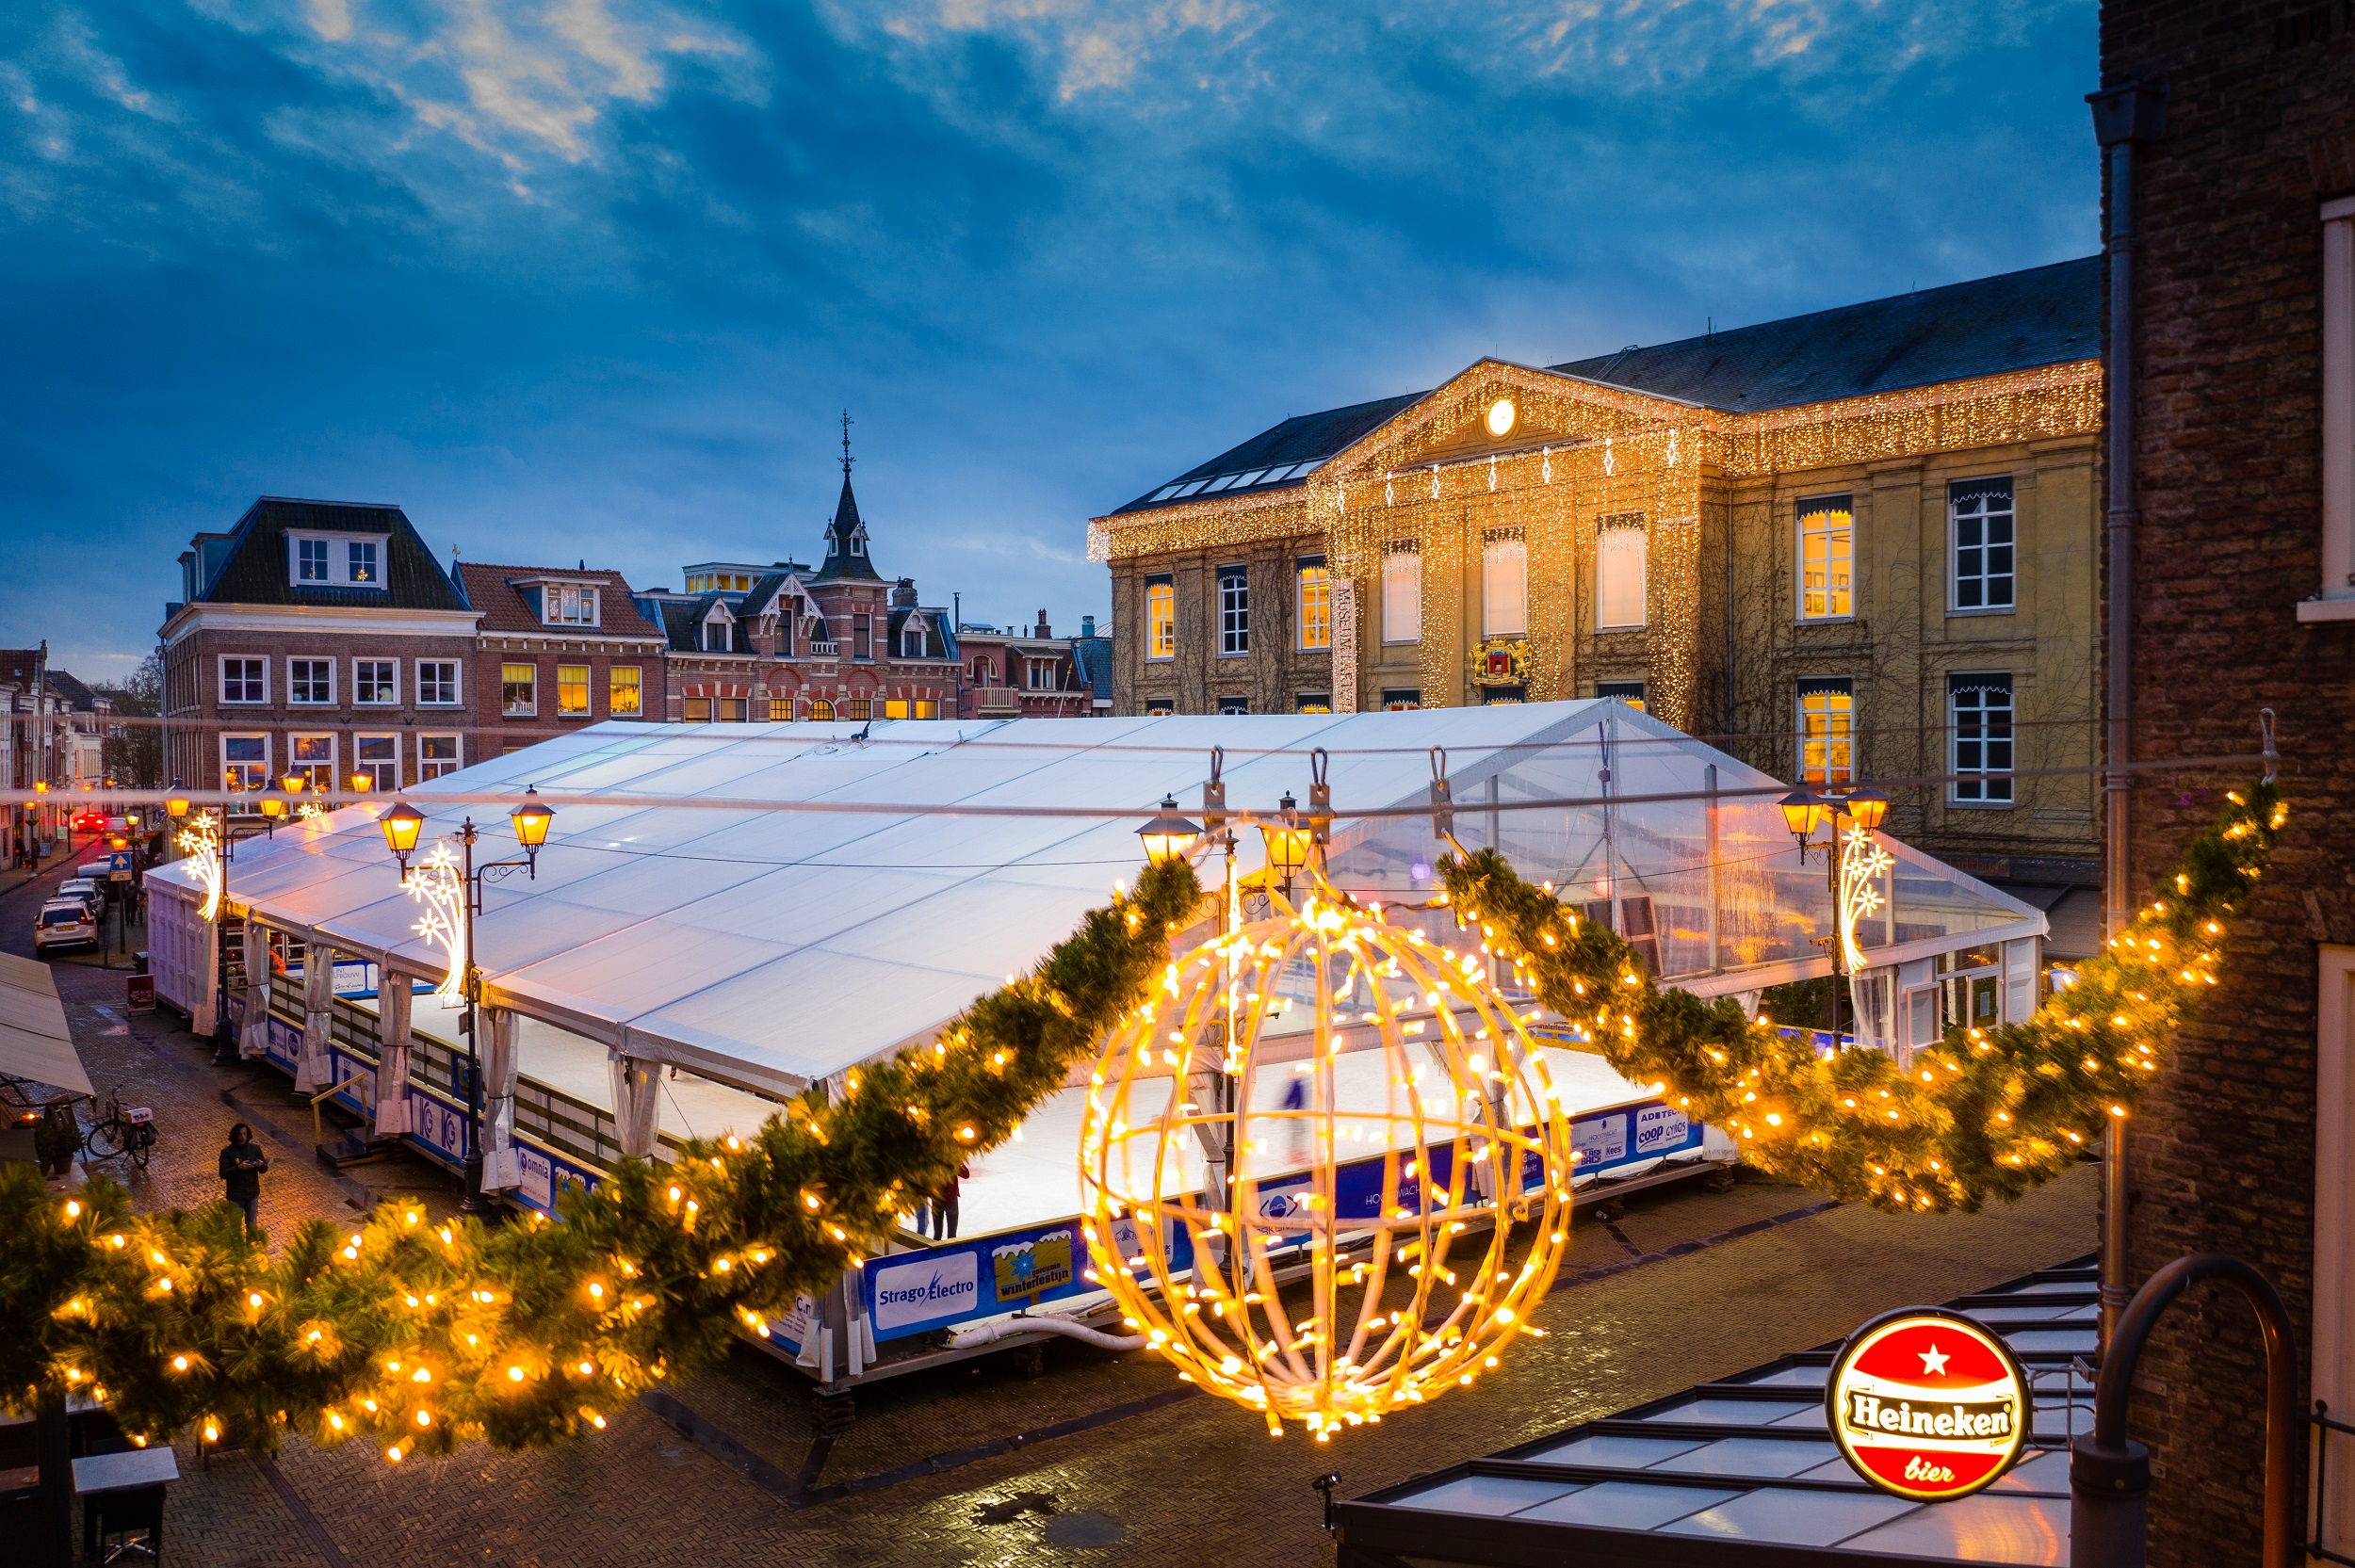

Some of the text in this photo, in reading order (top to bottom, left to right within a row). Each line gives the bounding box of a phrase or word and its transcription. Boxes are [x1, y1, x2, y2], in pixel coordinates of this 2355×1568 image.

[1521, 1153, 1538, 1163] Grote
[1606, 1145, 1622, 1156] Kees
[528, 1158, 549, 1179] omnia
[1520, 1163, 1537, 1175] Markt
[1031, 1262, 1061, 1278] gorcums
[879, 1281, 974, 1305] Strago Electro
[1000, 1269, 1069, 1297] winterfestijn
[1853, 1394, 2010, 1436] Heineken
[1904, 1455, 1956, 1482] bier
